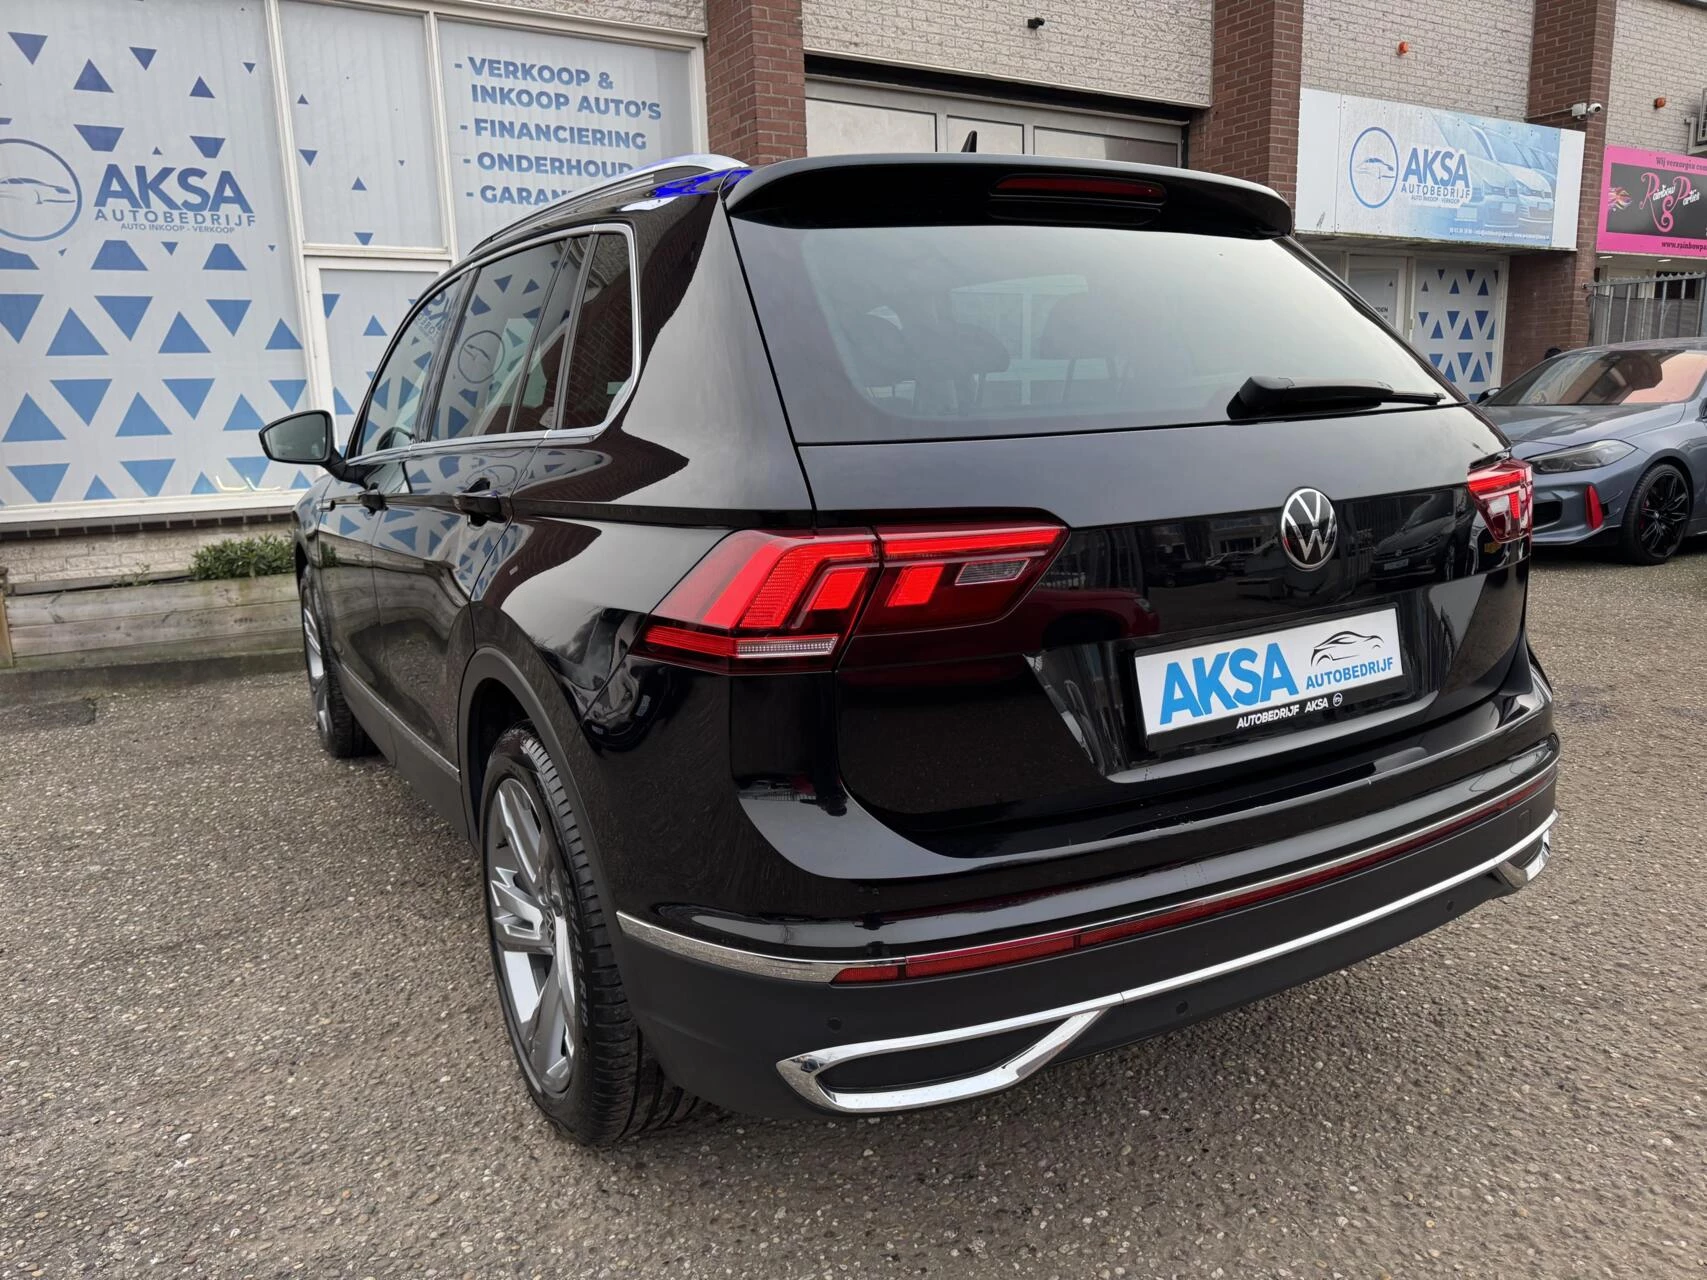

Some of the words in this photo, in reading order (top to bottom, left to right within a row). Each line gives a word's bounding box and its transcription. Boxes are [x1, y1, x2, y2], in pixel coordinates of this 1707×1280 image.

[468, 56, 590, 87] VERKOOP
[598, 72, 614, 90] &
[471, 84, 570, 111] INKOOP
[577, 95, 662, 121] AUTO'S
[474, 118, 647, 150] FINANCIERING
[477, 151, 634, 178] ONDERHOUD
[1402, 147, 1471, 188] AKSA
[94, 163, 254, 213] AKSA
[1401, 183, 1471, 199] AUTOBEDRIJF
[94, 208, 256, 227] AUTOBEDRIJF
[120, 222, 146, 231] AUTO
[149, 224, 185, 232] INKOOP
[192, 226, 235, 234] VERKOOP
[1160, 642, 1299, 725] AKSA
[1306, 656, 1393, 690] AUTOBEDRIJF
[1236, 704, 1300, 730] AUTOBEDRIJF
[1304, 697, 1329, 713] AKSA
